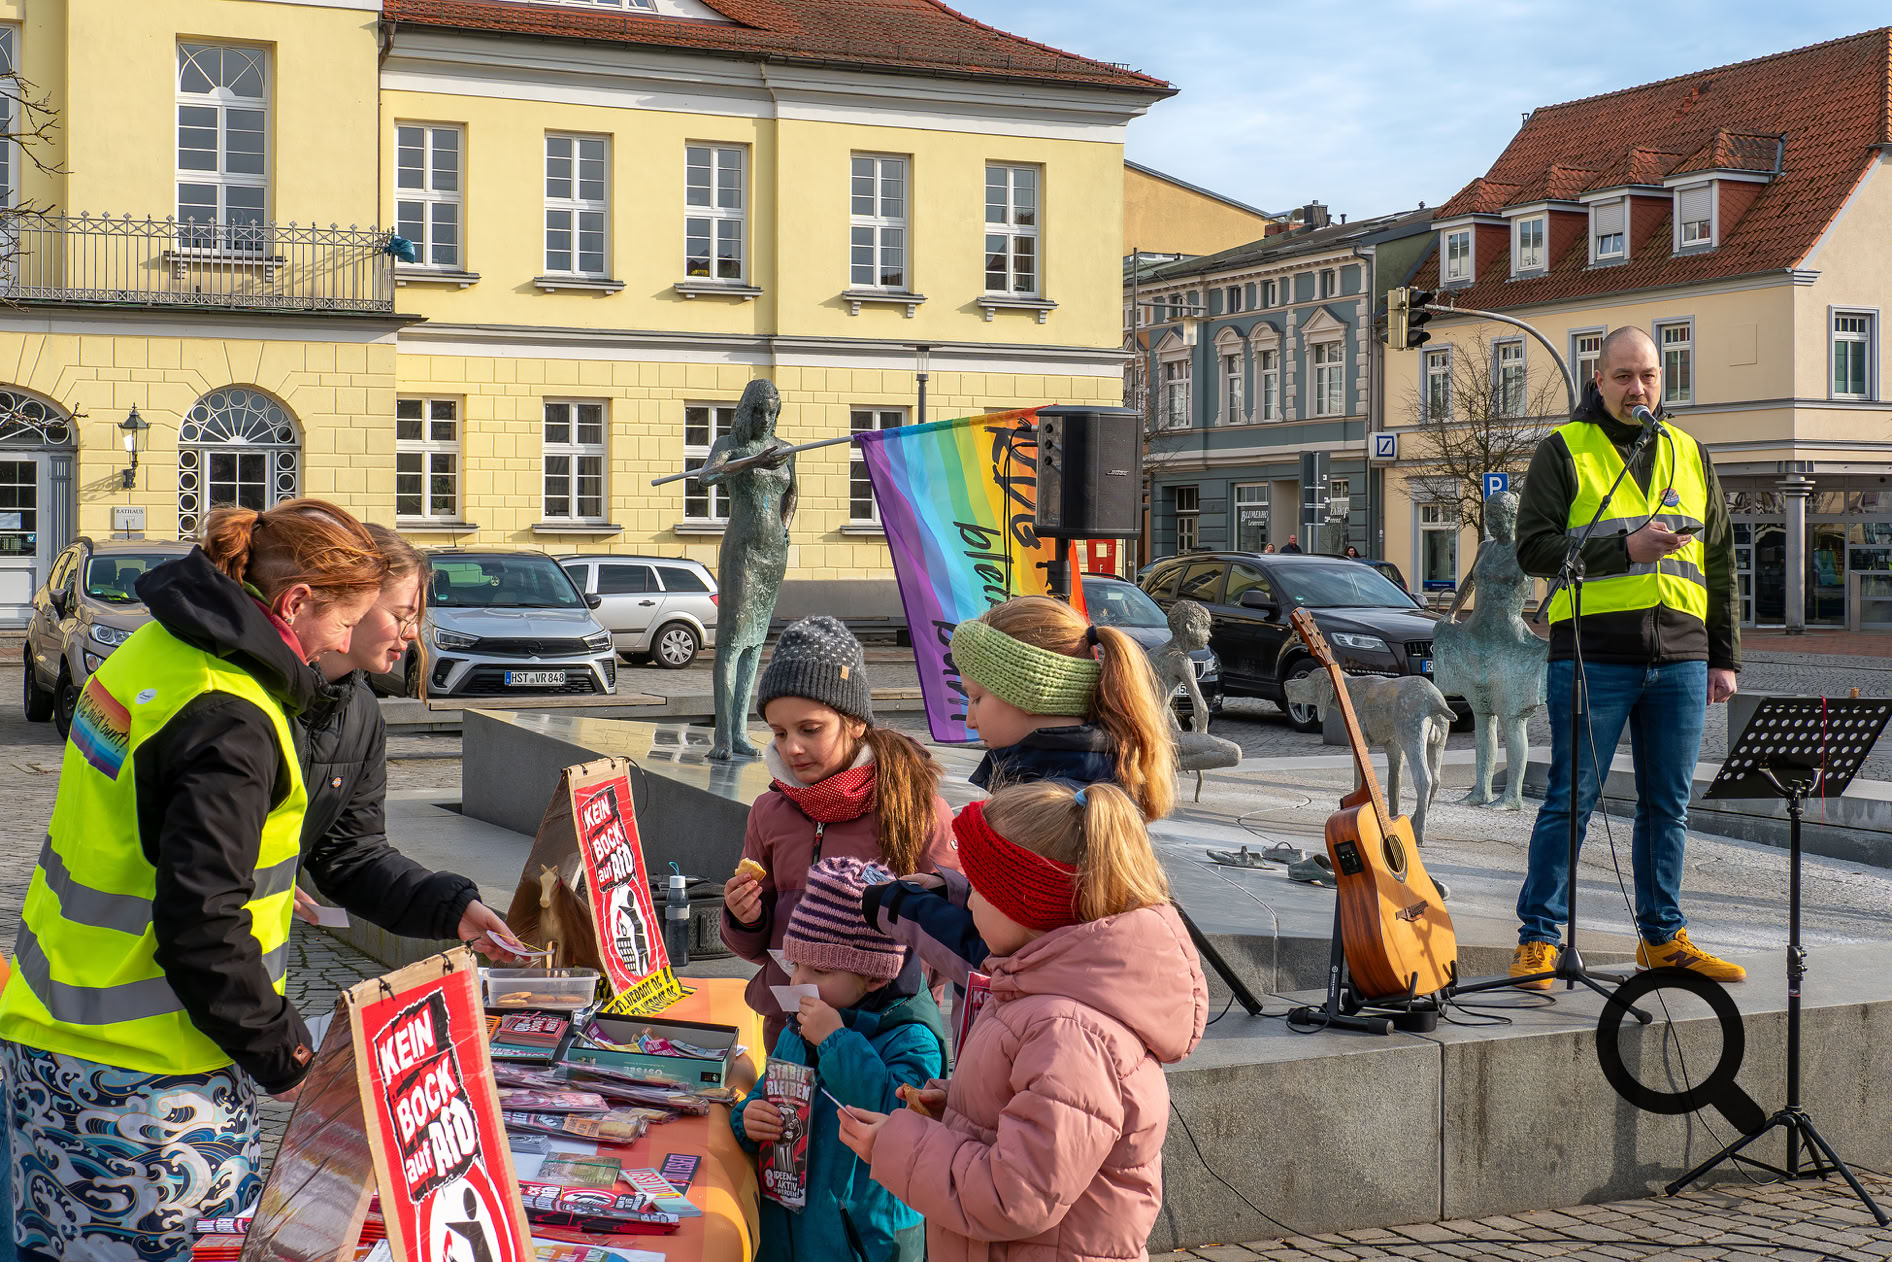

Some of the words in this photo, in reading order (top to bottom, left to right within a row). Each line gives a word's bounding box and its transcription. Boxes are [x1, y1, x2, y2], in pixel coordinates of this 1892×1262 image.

[1489, 476, 1502, 495] P
[511, 672, 528, 683] HST
[536, 672, 547, 683] VR
[548, 672, 565, 683] 848
[584, 795, 611, 831] KEIN
[592, 821, 623, 863] BOCK
[597, 862, 612, 883] auf
[610, 842, 634, 882] AfD
[380, 1009, 435, 1085] KEIN
[767, 1064, 807, 1083] STABIL
[396, 1055, 457, 1143] BOCK
[766, 1080, 811, 1101] BLEIBEN
[406, 1139, 432, 1184] auf
[428, 1098, 477, 1177] AfD
[765, 1169, 774, 1187] 8
[774, 1171, 792, 1181] IDEEN
[777, 1180, 798, 1191] AKTIV
